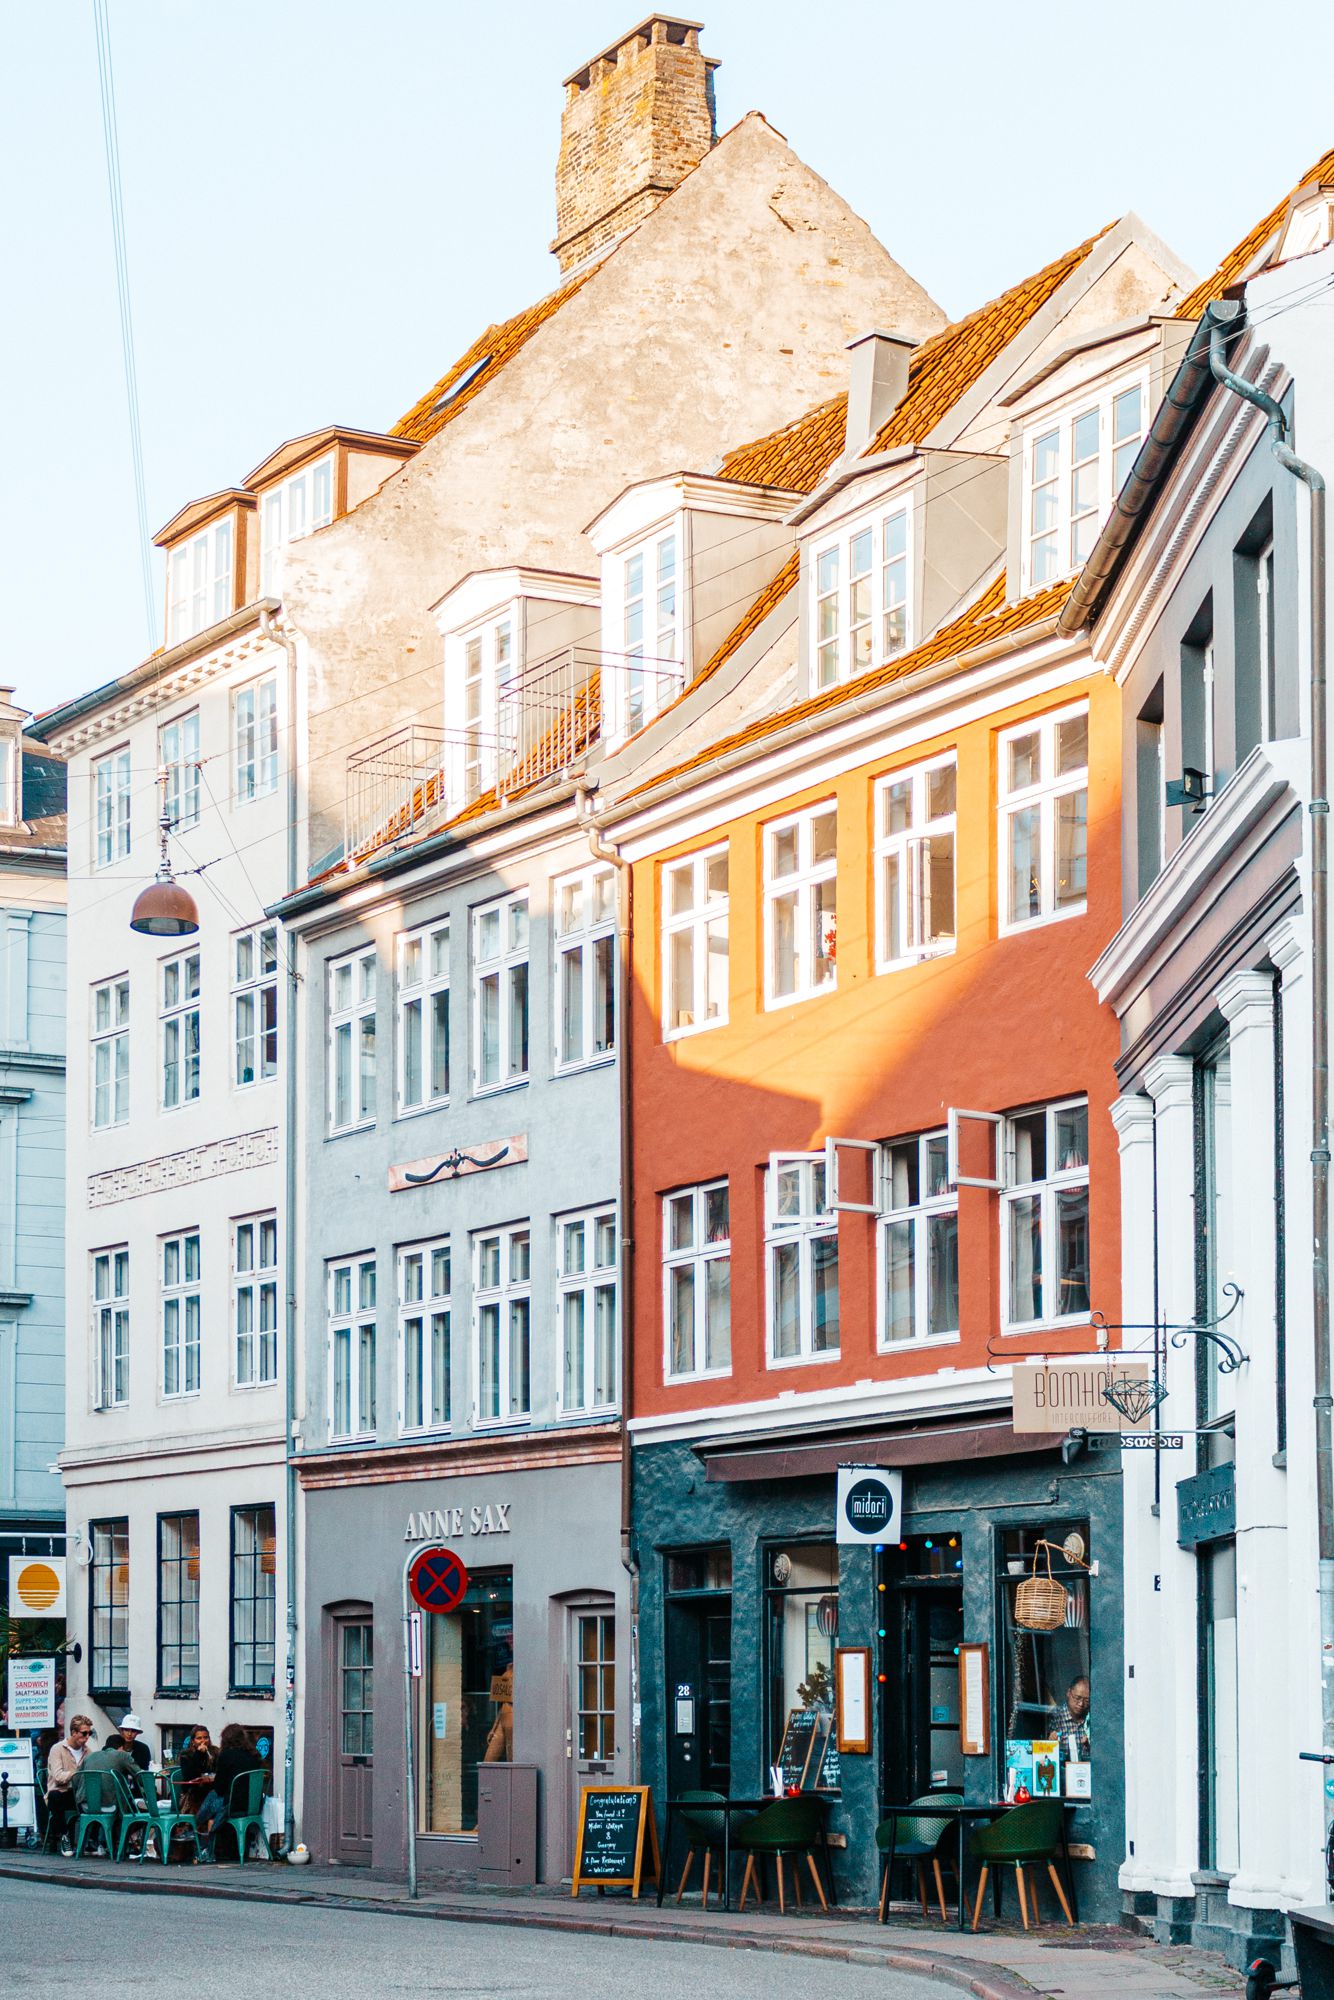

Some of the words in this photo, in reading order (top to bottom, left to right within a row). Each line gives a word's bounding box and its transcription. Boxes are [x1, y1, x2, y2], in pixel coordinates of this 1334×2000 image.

[854, 1491, 885, 1514] midori
[403, 1508, 464, 1541] ANNE
[470, 1503, 511, 1536] SAX
[678, 1685, 690, 1696] 28
